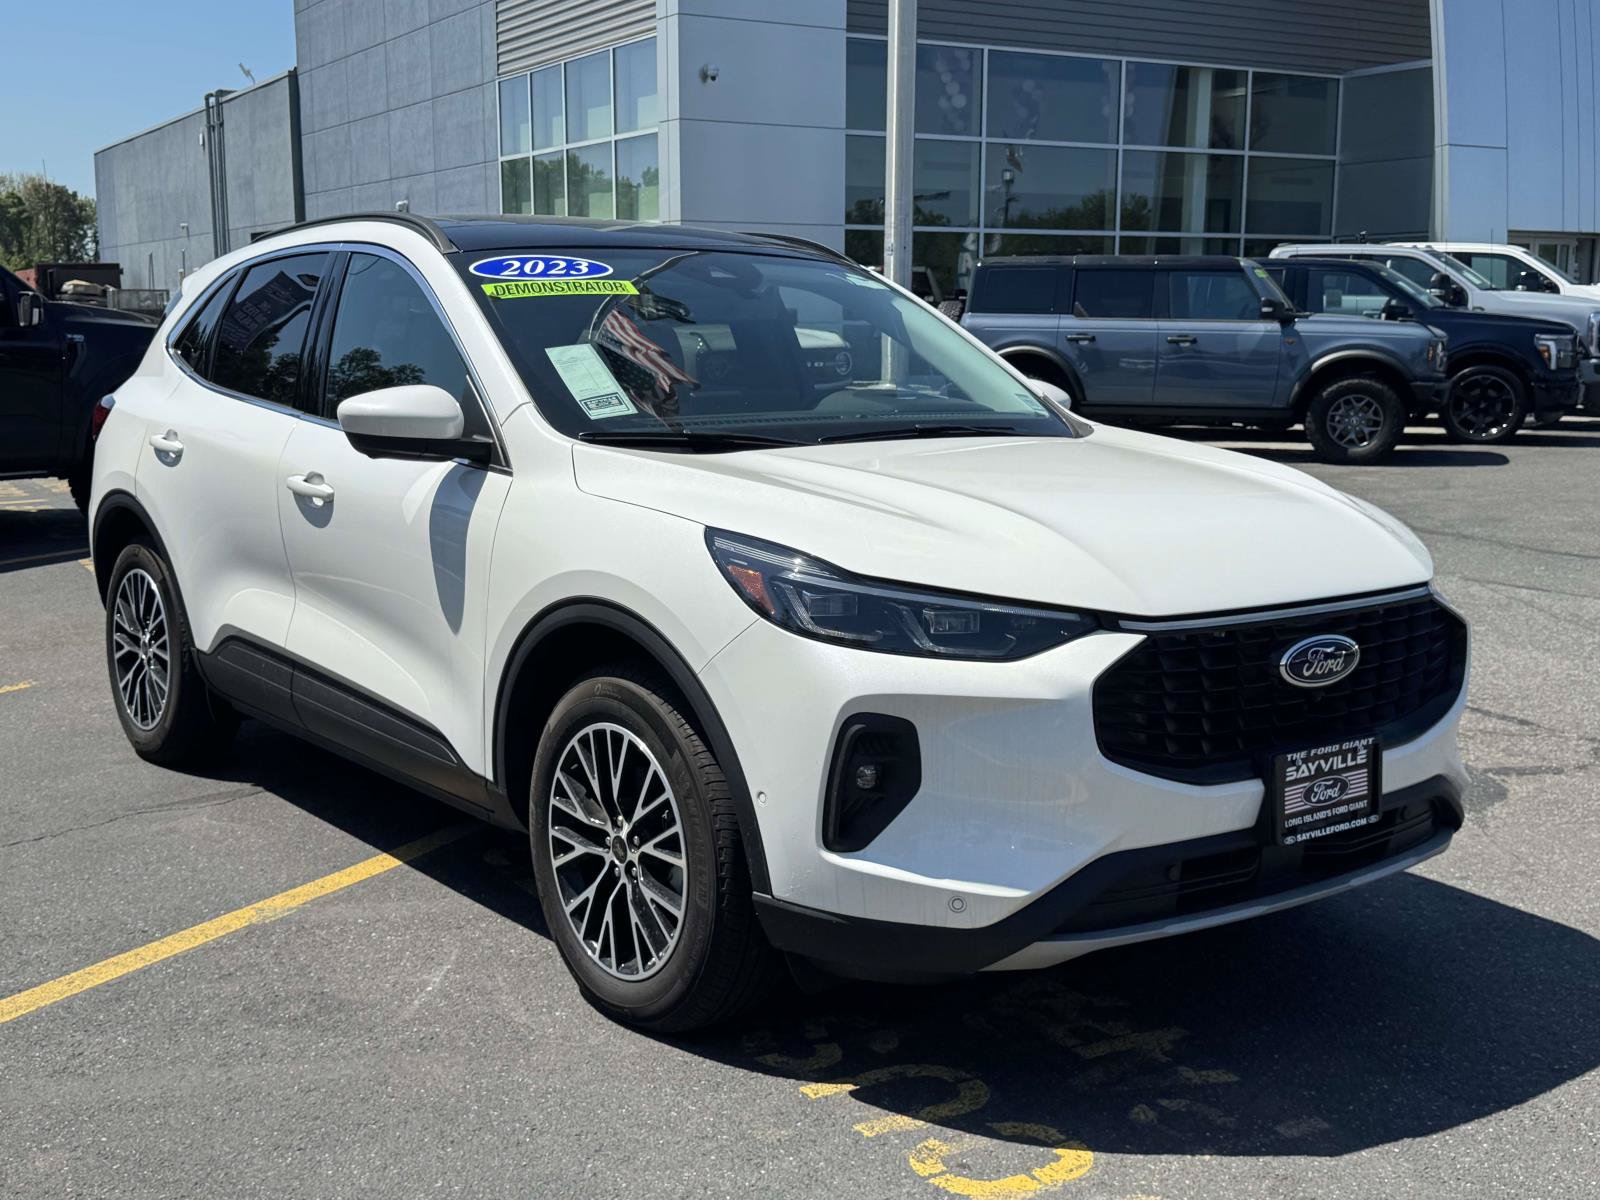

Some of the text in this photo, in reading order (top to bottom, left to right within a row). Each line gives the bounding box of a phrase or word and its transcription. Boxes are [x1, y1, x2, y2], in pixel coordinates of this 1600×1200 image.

[499, 259, 589, 276] 2023
[493, 281, 626, 297] DEMONSTRATOR
[1303, 647, 1345, 677] Ford
[1286, 737, 1375, 762] THE FORD GIANT
[1285, 749, 1368, 782] SAYVILLE
[1311, 780, 1341, 803] Ford
[1285, 800, 1368, 828] LONG ISLAND'S FORD GIANT
[1296, 817, 1367, 842] SAYVILLEFORD.COM
